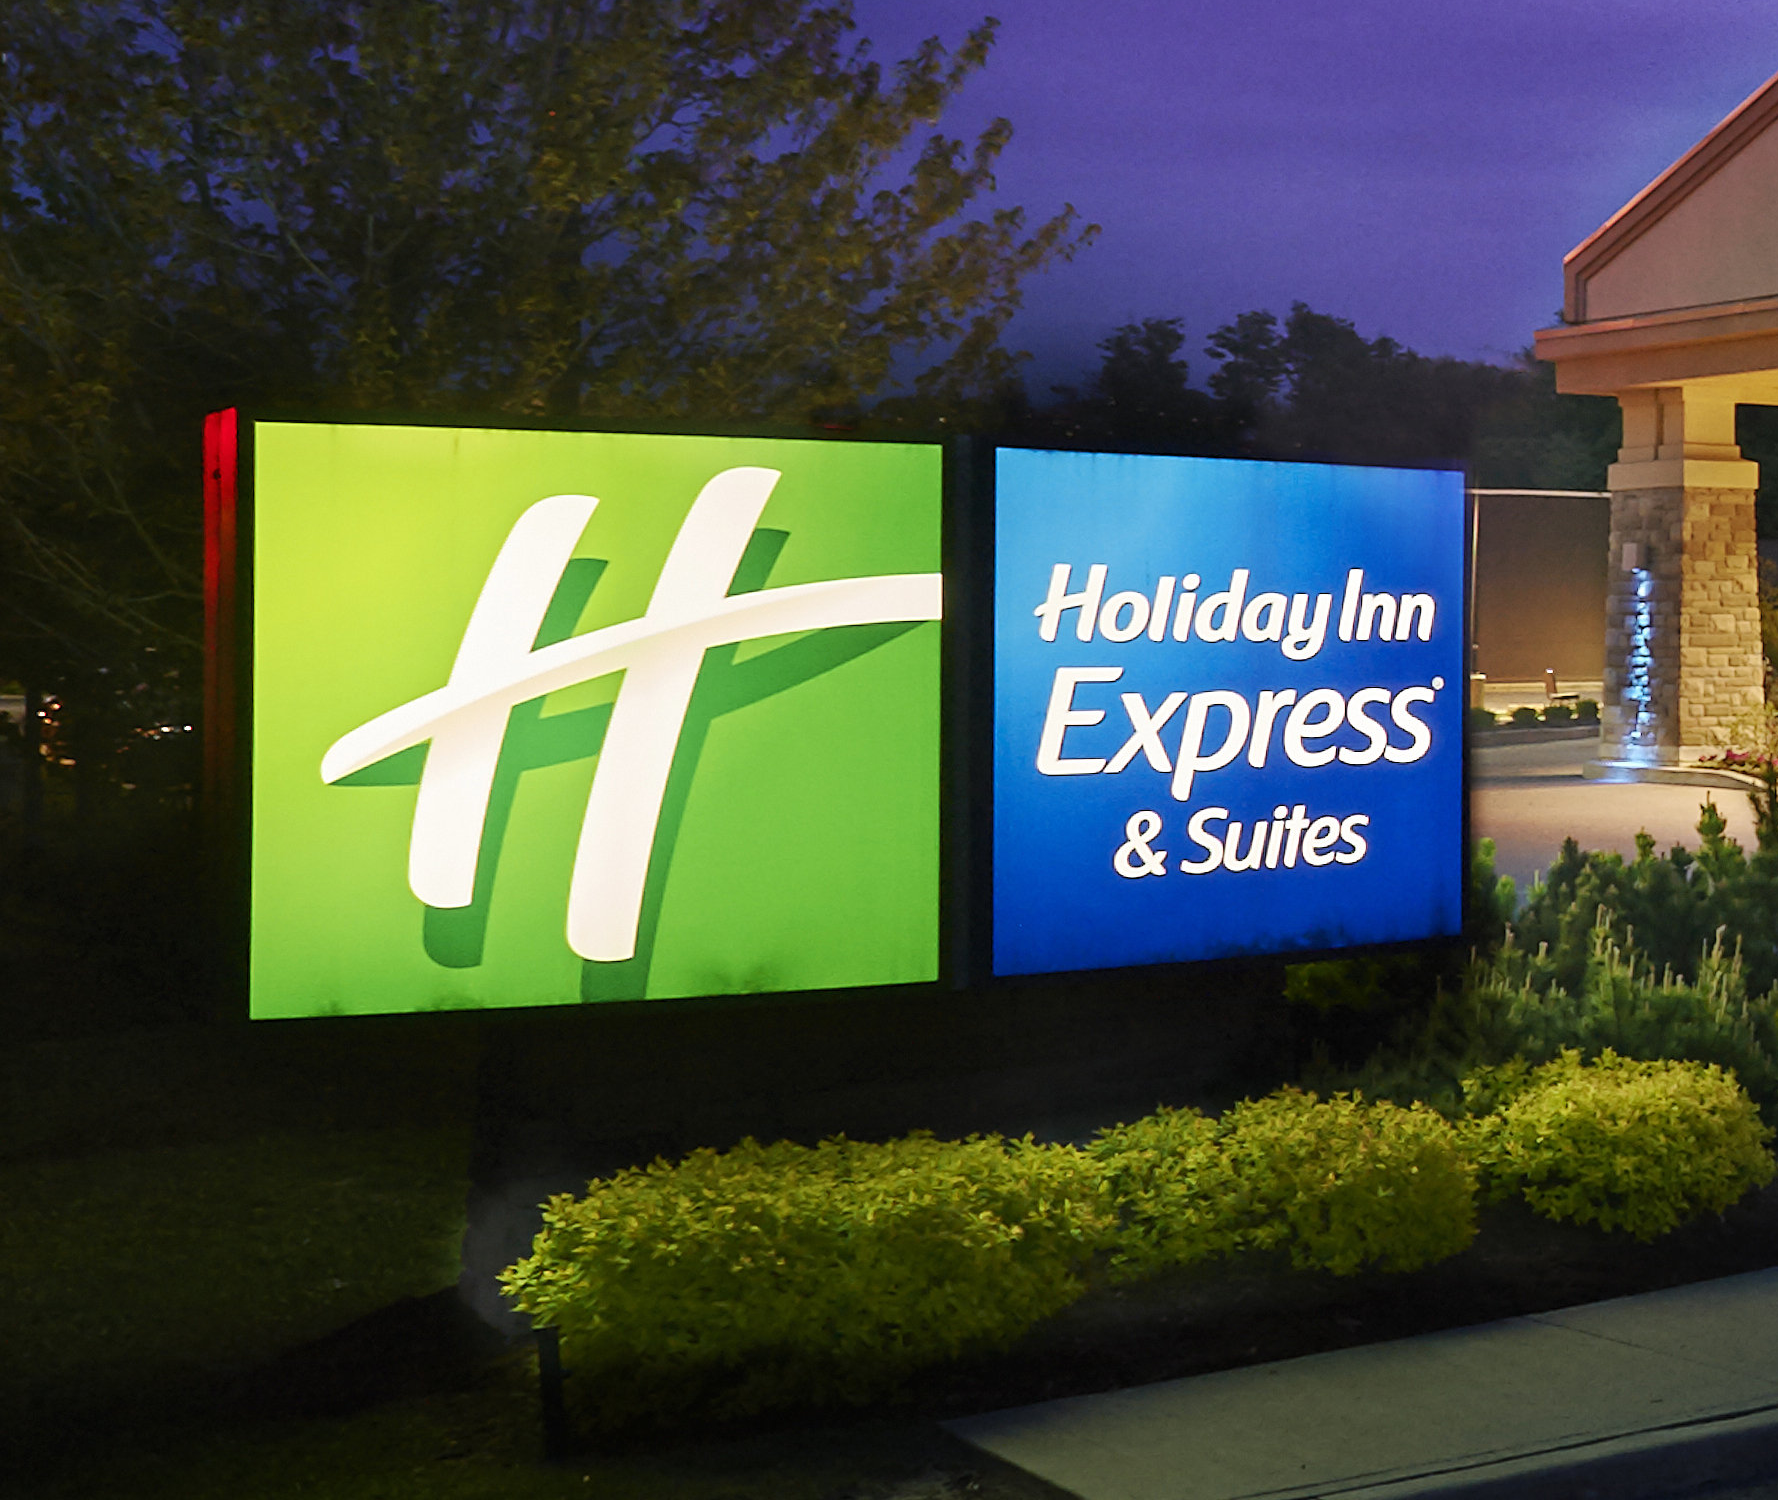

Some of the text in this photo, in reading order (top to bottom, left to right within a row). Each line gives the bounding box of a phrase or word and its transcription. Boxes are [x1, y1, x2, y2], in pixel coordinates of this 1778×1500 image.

[1033, 562, 1436, 661] Holiday Inn
[1036, 666, 1436, 802] Express
[1113, 804, 1370, 878] & Suites
